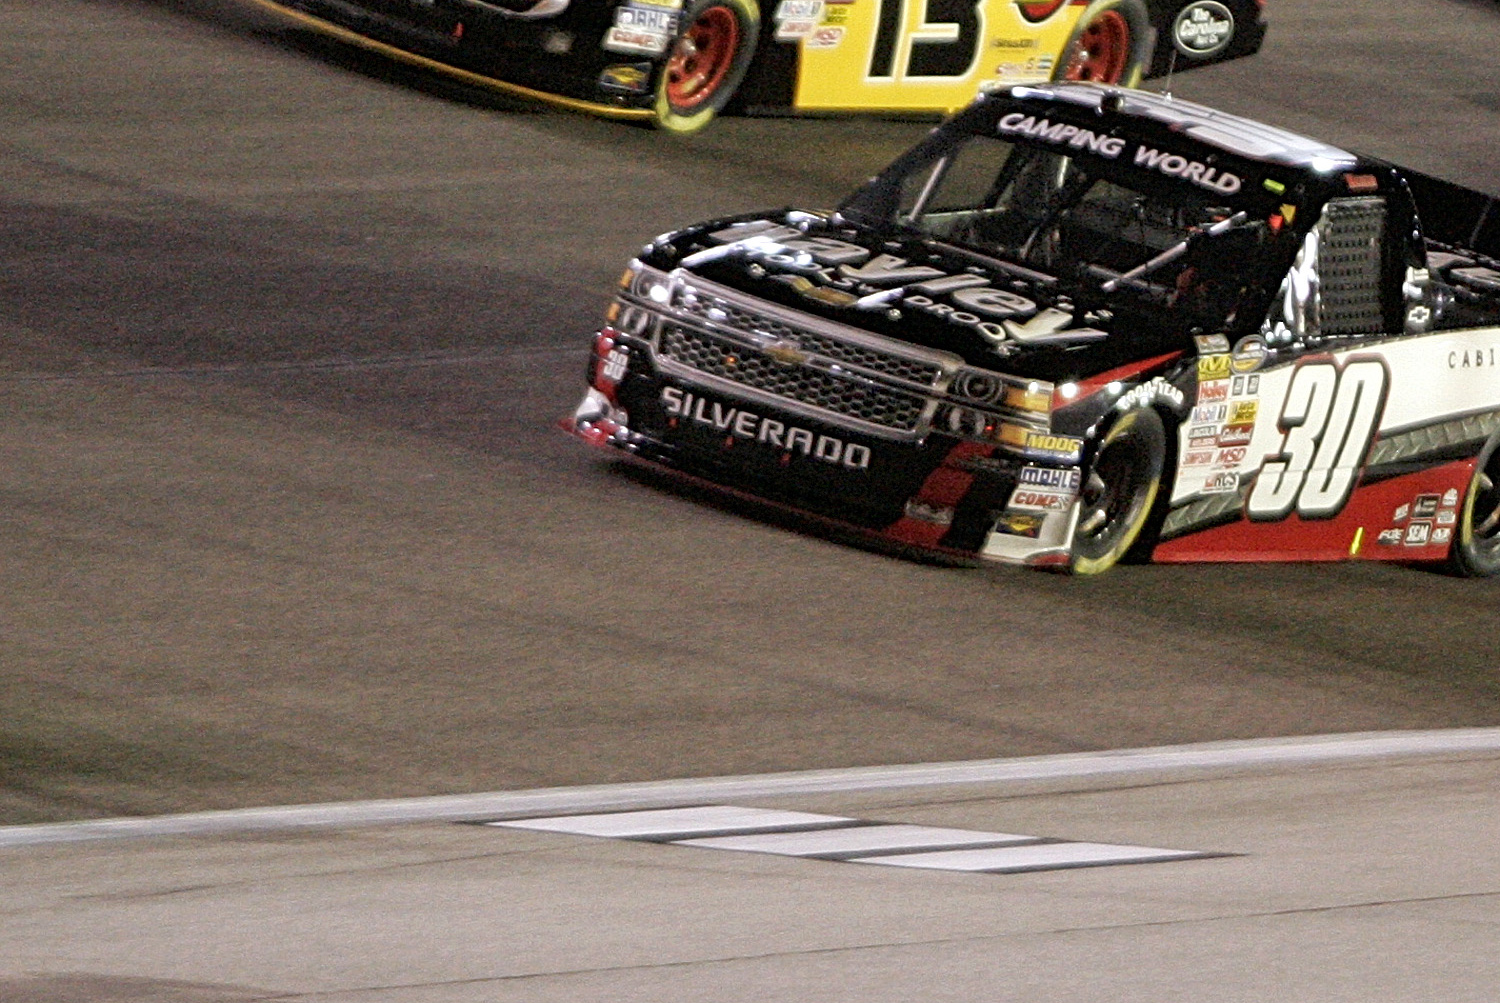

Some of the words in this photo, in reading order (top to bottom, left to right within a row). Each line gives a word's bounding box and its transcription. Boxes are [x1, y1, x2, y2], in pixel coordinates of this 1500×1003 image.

[610, 7, 681, 37] AHLE
[998, 112, 1127, 158] CAMPING
[1133, 145, 1242, 195] WORLD
[660, 385, 873, 470] SILVERADO
[1245, 354, 1391, 521] 30
[1030, 434, 1081, 453] MOOG
[1022, 468, 1082, 491] MAHLE
[1014, 492, 1060, 507] COMP
